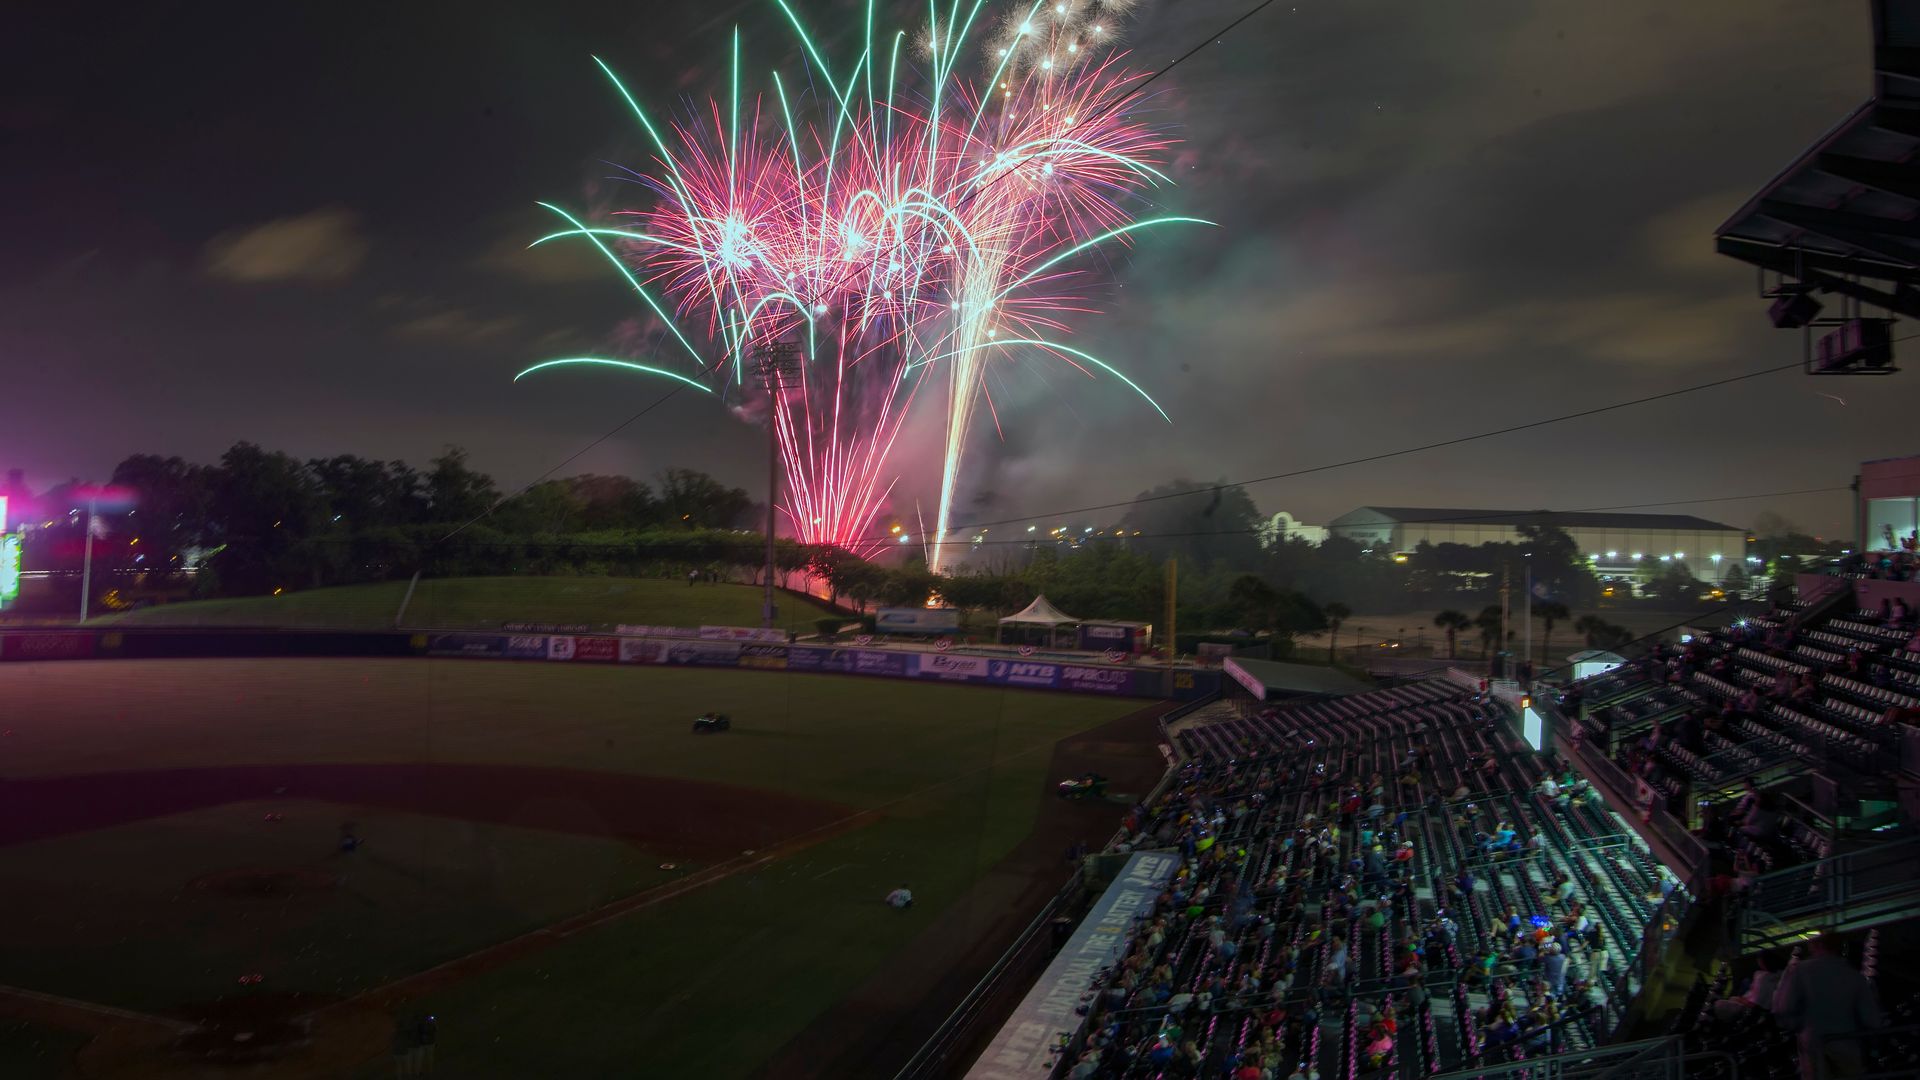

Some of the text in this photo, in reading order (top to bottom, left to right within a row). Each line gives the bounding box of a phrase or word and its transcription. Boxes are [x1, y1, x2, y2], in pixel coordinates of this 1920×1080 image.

[1009, 664, 1055, 677] NTB
[1062, 667, 1128, 684] SUPERCUTS
[1132, 856, 1159, 877] NTB
[1037, 957, 1103, 1016] NATIONAL
[1079, 934, 1117, 953] TIRE
[1100, 889, 1147, 926] BATTERY
